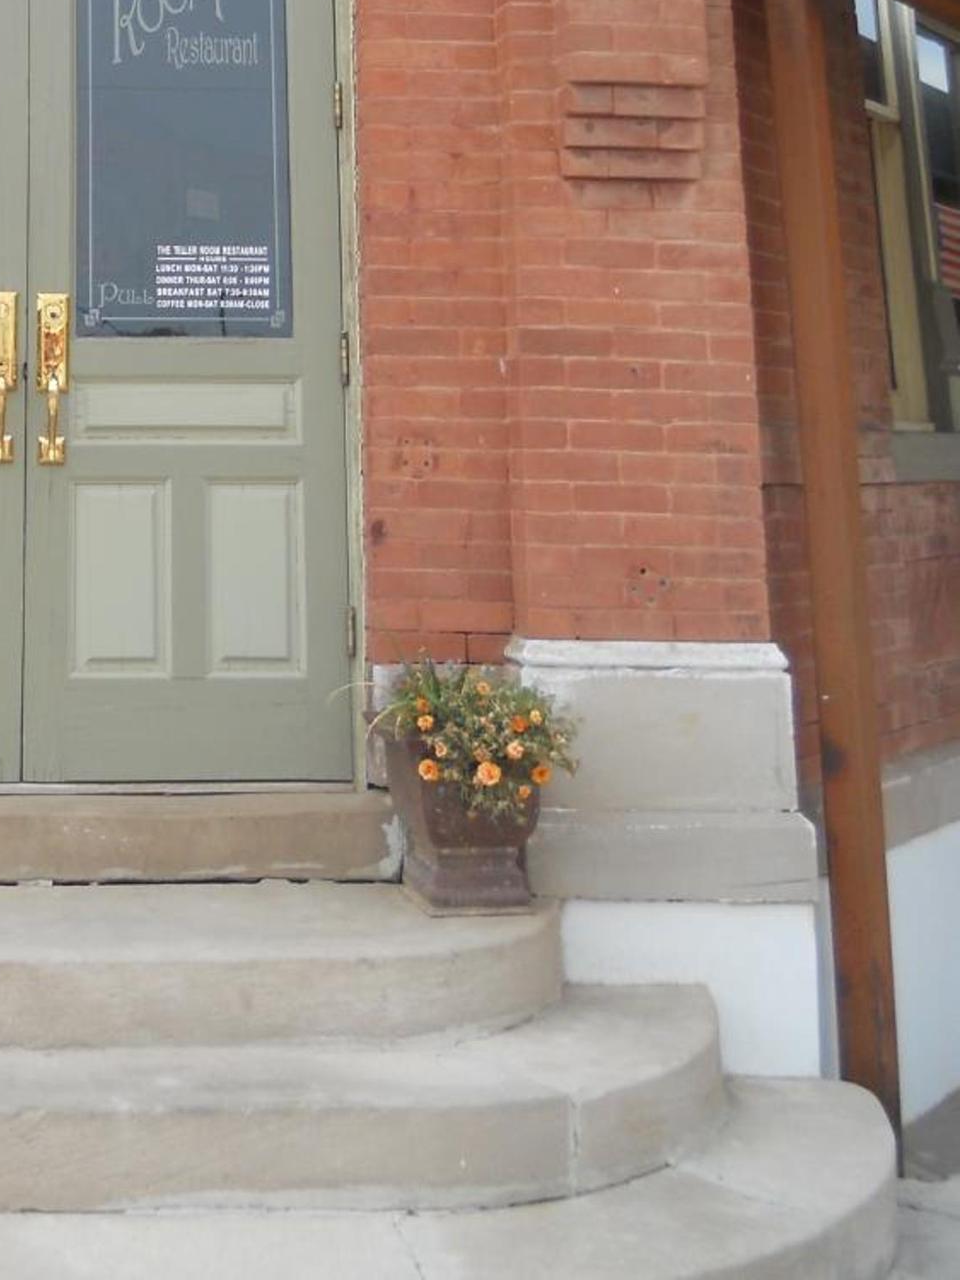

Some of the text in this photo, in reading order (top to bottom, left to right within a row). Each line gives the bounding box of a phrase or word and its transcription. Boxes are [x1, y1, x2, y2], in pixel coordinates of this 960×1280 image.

[166, 26, 259, 69] Restaurant
[157, 245, 171, 255] THE
[200, 245, 220, 255] ROOM
[222, 245, 268, 256] RESTAURANT
[156, 264, 182, 273] LUNCH
[156, 276, 184, 285] DINNER
[156, 288, 204, 297] BREAKFAST
[206, 288, 223, 297] SAT
[156, 299, 185, 309] COFFEE
